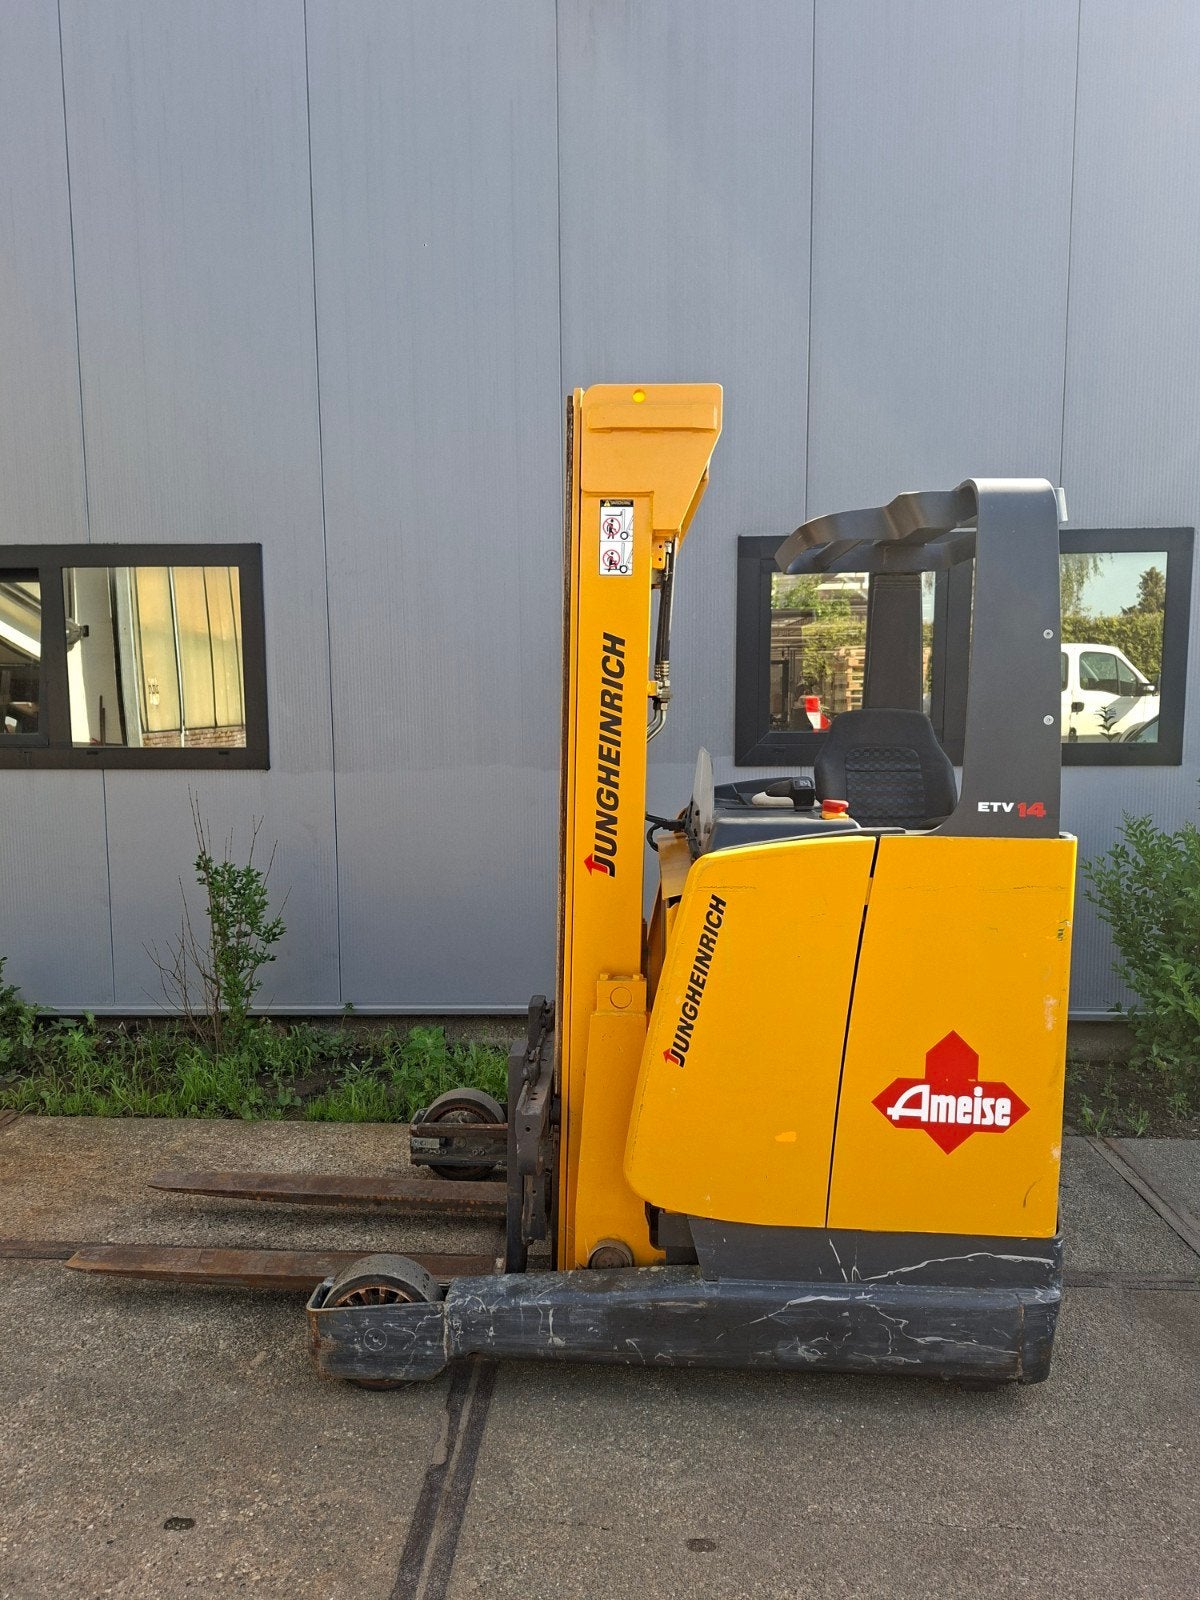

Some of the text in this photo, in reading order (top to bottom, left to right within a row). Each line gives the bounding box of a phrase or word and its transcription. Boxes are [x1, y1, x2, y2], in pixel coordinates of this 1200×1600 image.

[590, 632, 627, 878] JUNGHEINRICH
[977, 801, 1047, 818] ETV 14
[669, 893, 727, 1068] JUNGHEINRICH
[886, 1084, 1012, 1127] Ameise
